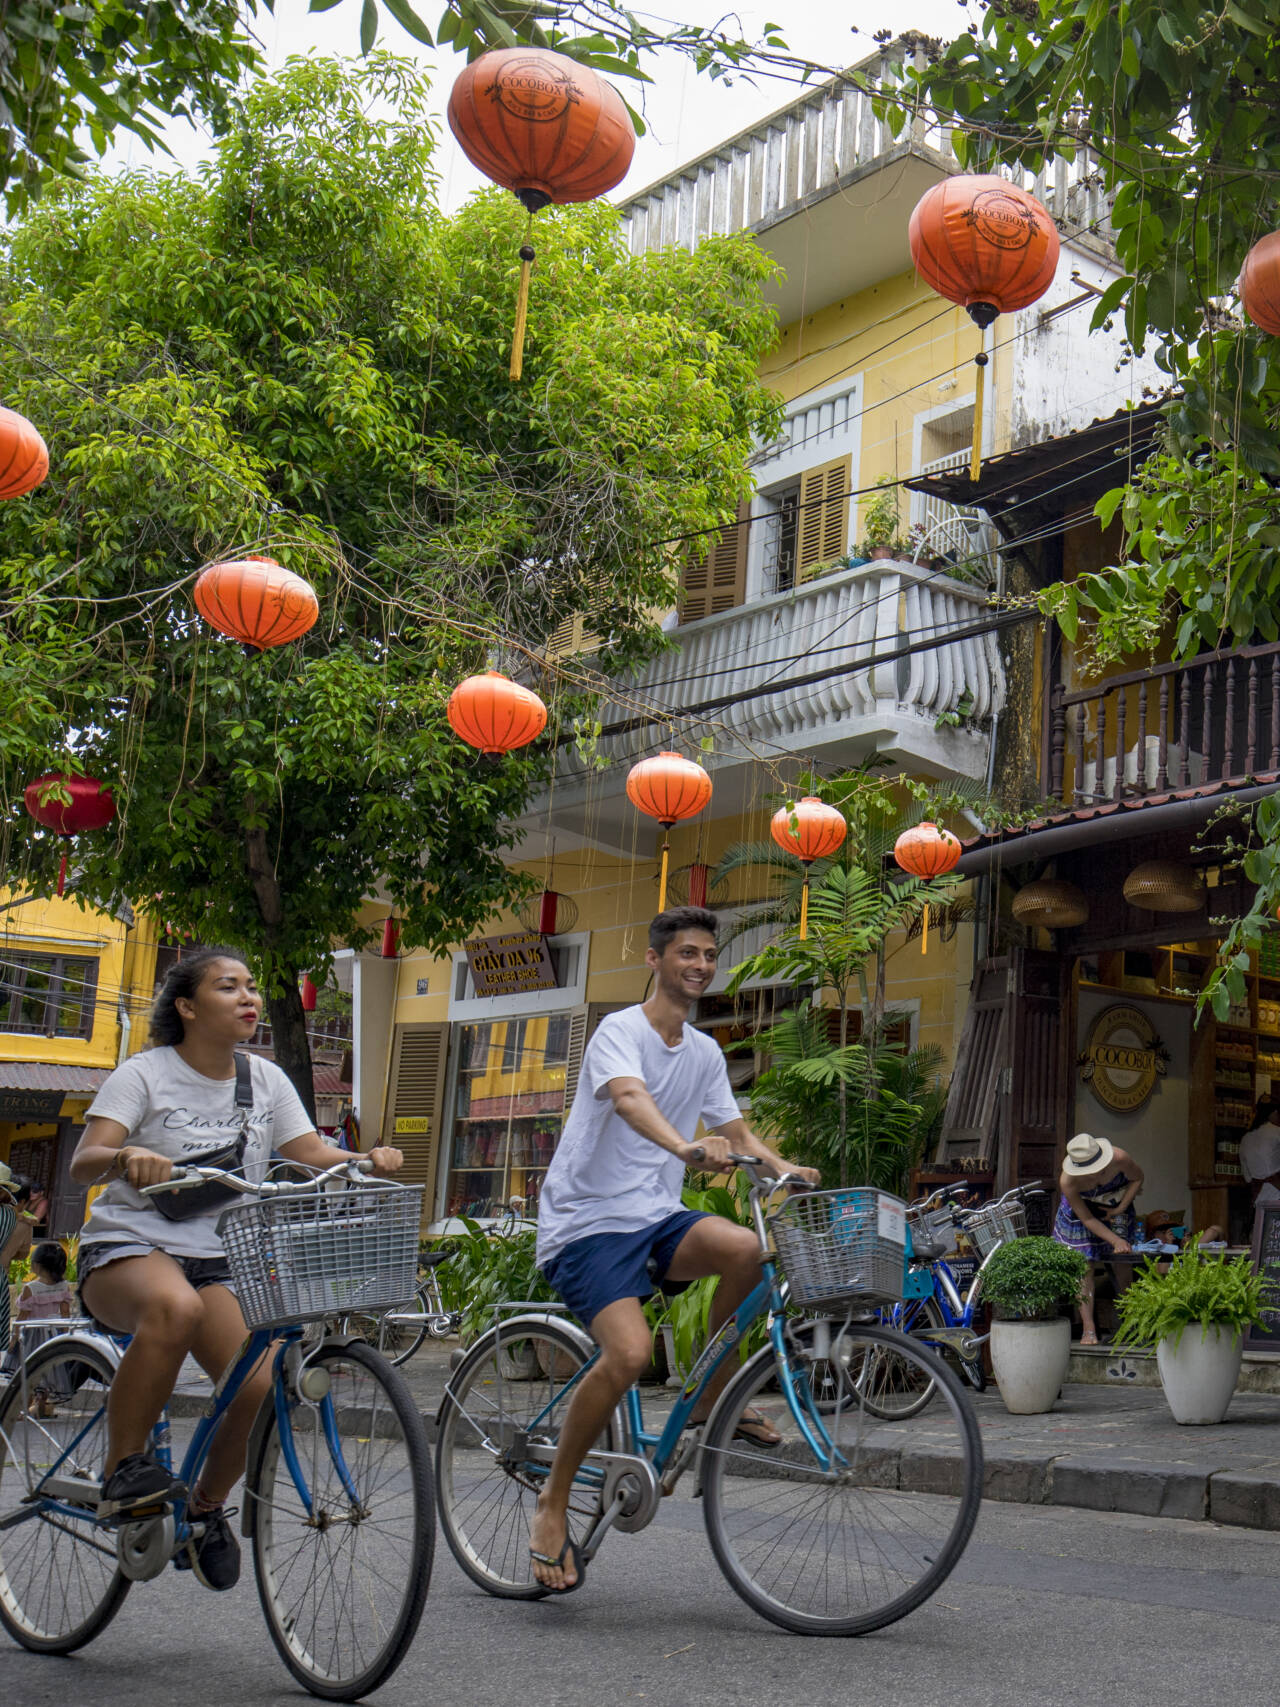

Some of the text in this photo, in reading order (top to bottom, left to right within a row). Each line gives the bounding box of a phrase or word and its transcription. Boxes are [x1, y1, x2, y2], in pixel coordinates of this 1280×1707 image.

[502, 76, 563, 96] COCOBOX
[977, 207, 1026, 229] COCOBOX
[473, 947, 543, 972] GIÀY DA 96
[484, 967, 540, 985] LEATHER SHOE
[406, 1120, 426, 1130] PARKING
